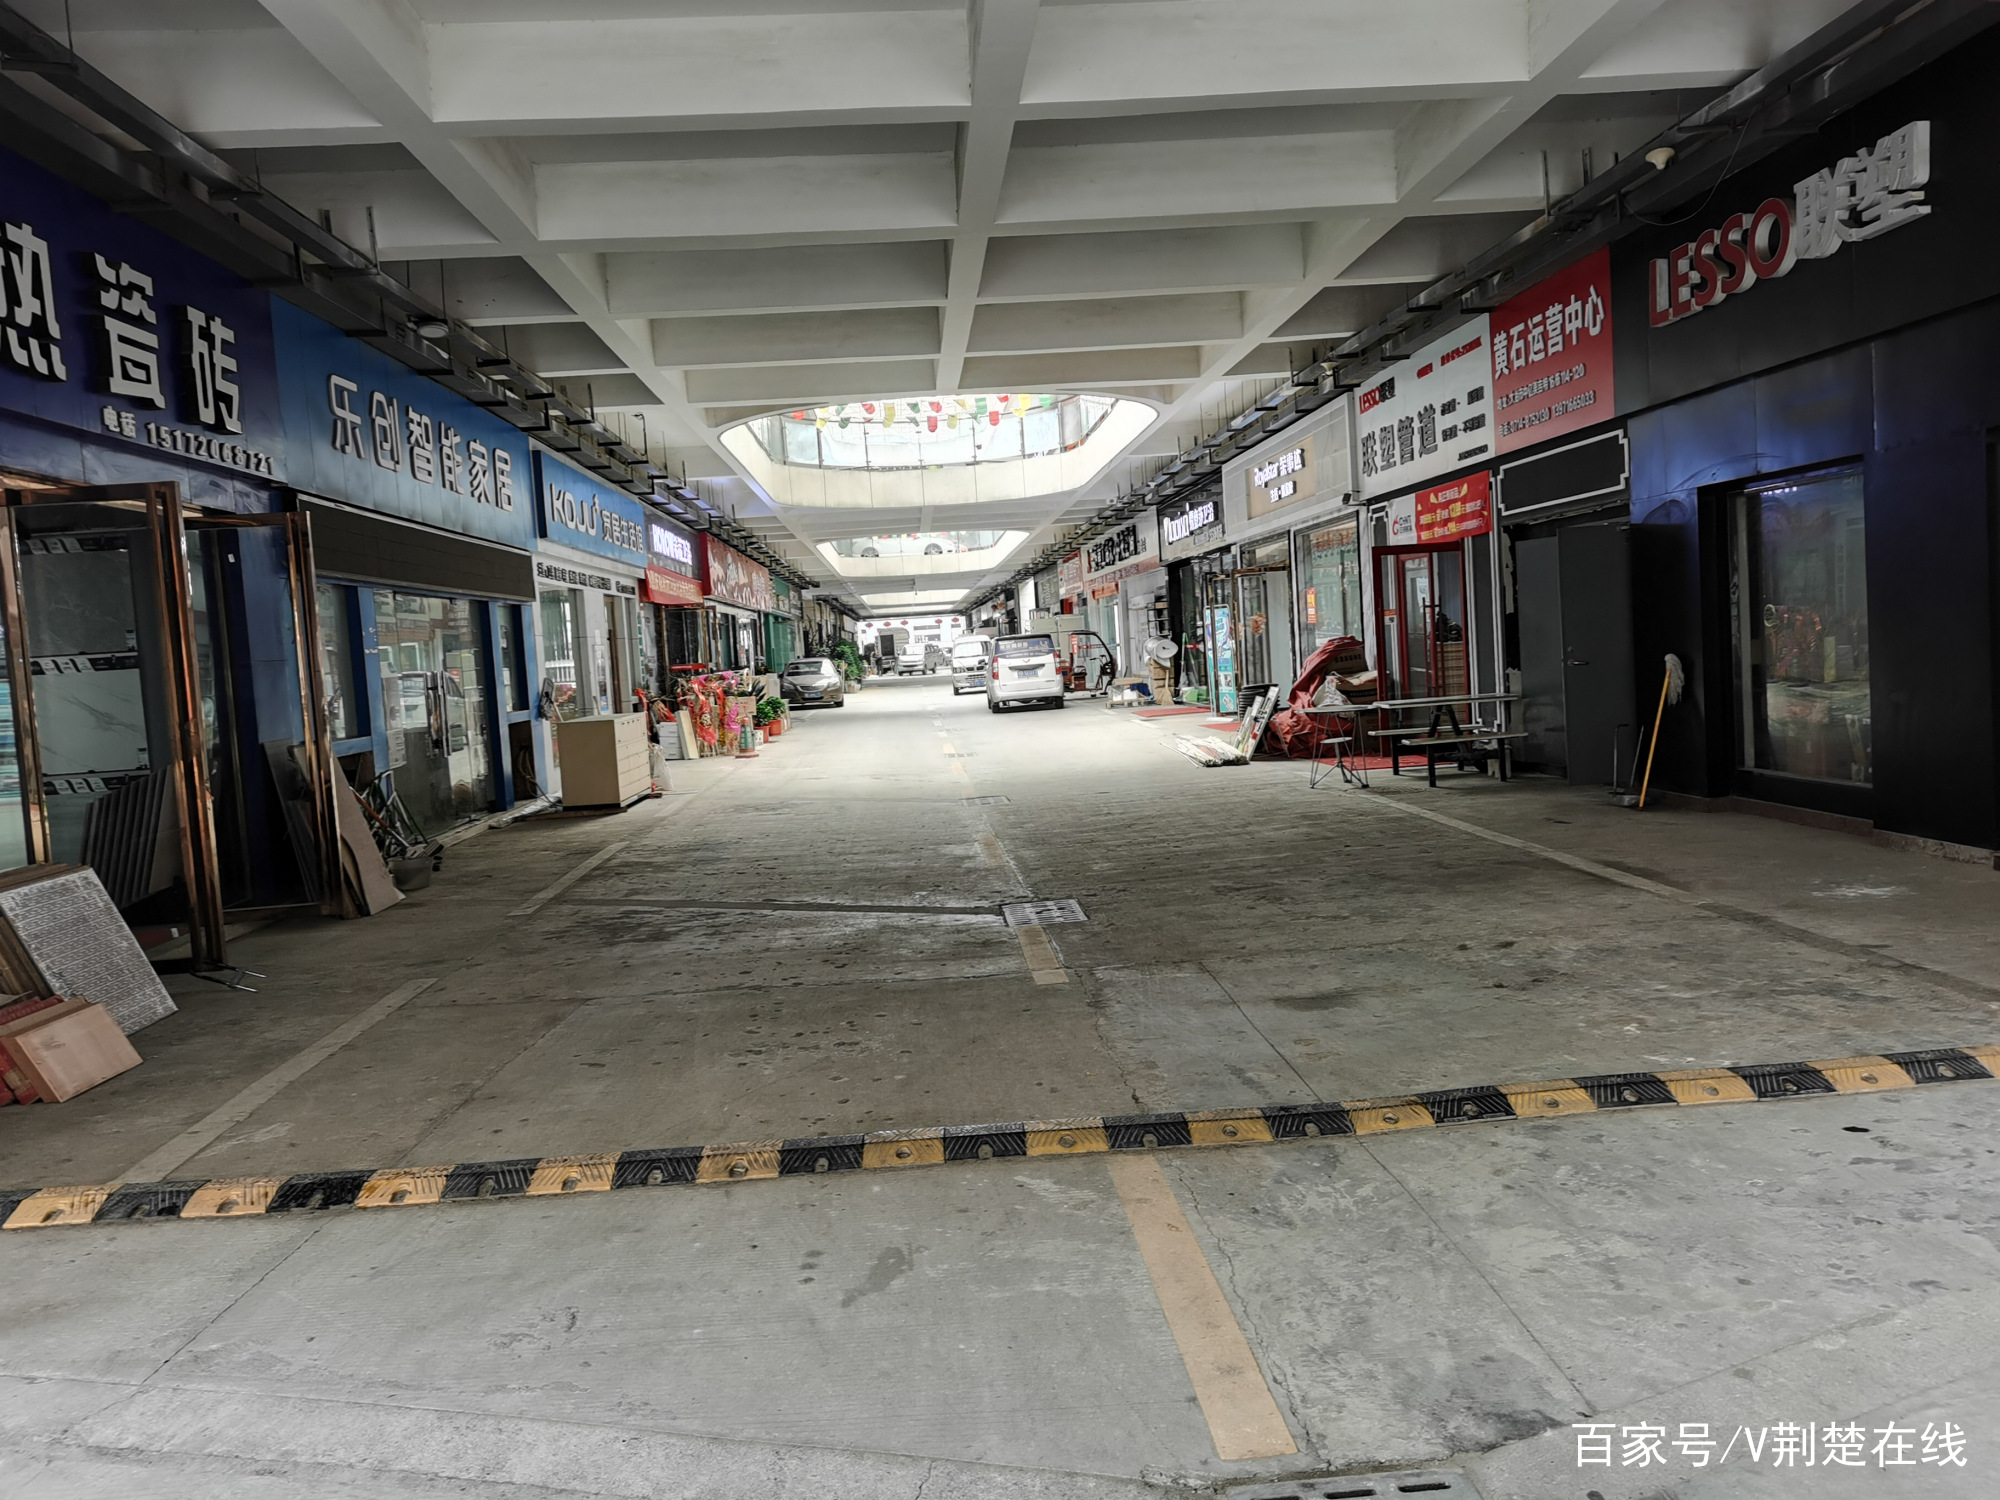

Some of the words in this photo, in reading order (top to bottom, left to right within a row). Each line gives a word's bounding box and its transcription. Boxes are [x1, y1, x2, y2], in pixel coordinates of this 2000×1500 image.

[1493, 284, 1605, 380] 黄石运营中心
[103, 405, 136, 438] 电话
[147, 422, 275, 475] 15172068721
[328, 374, 514, 512] 乐创智能家居
[1361, 403, 1439, 478] 联塑管道
